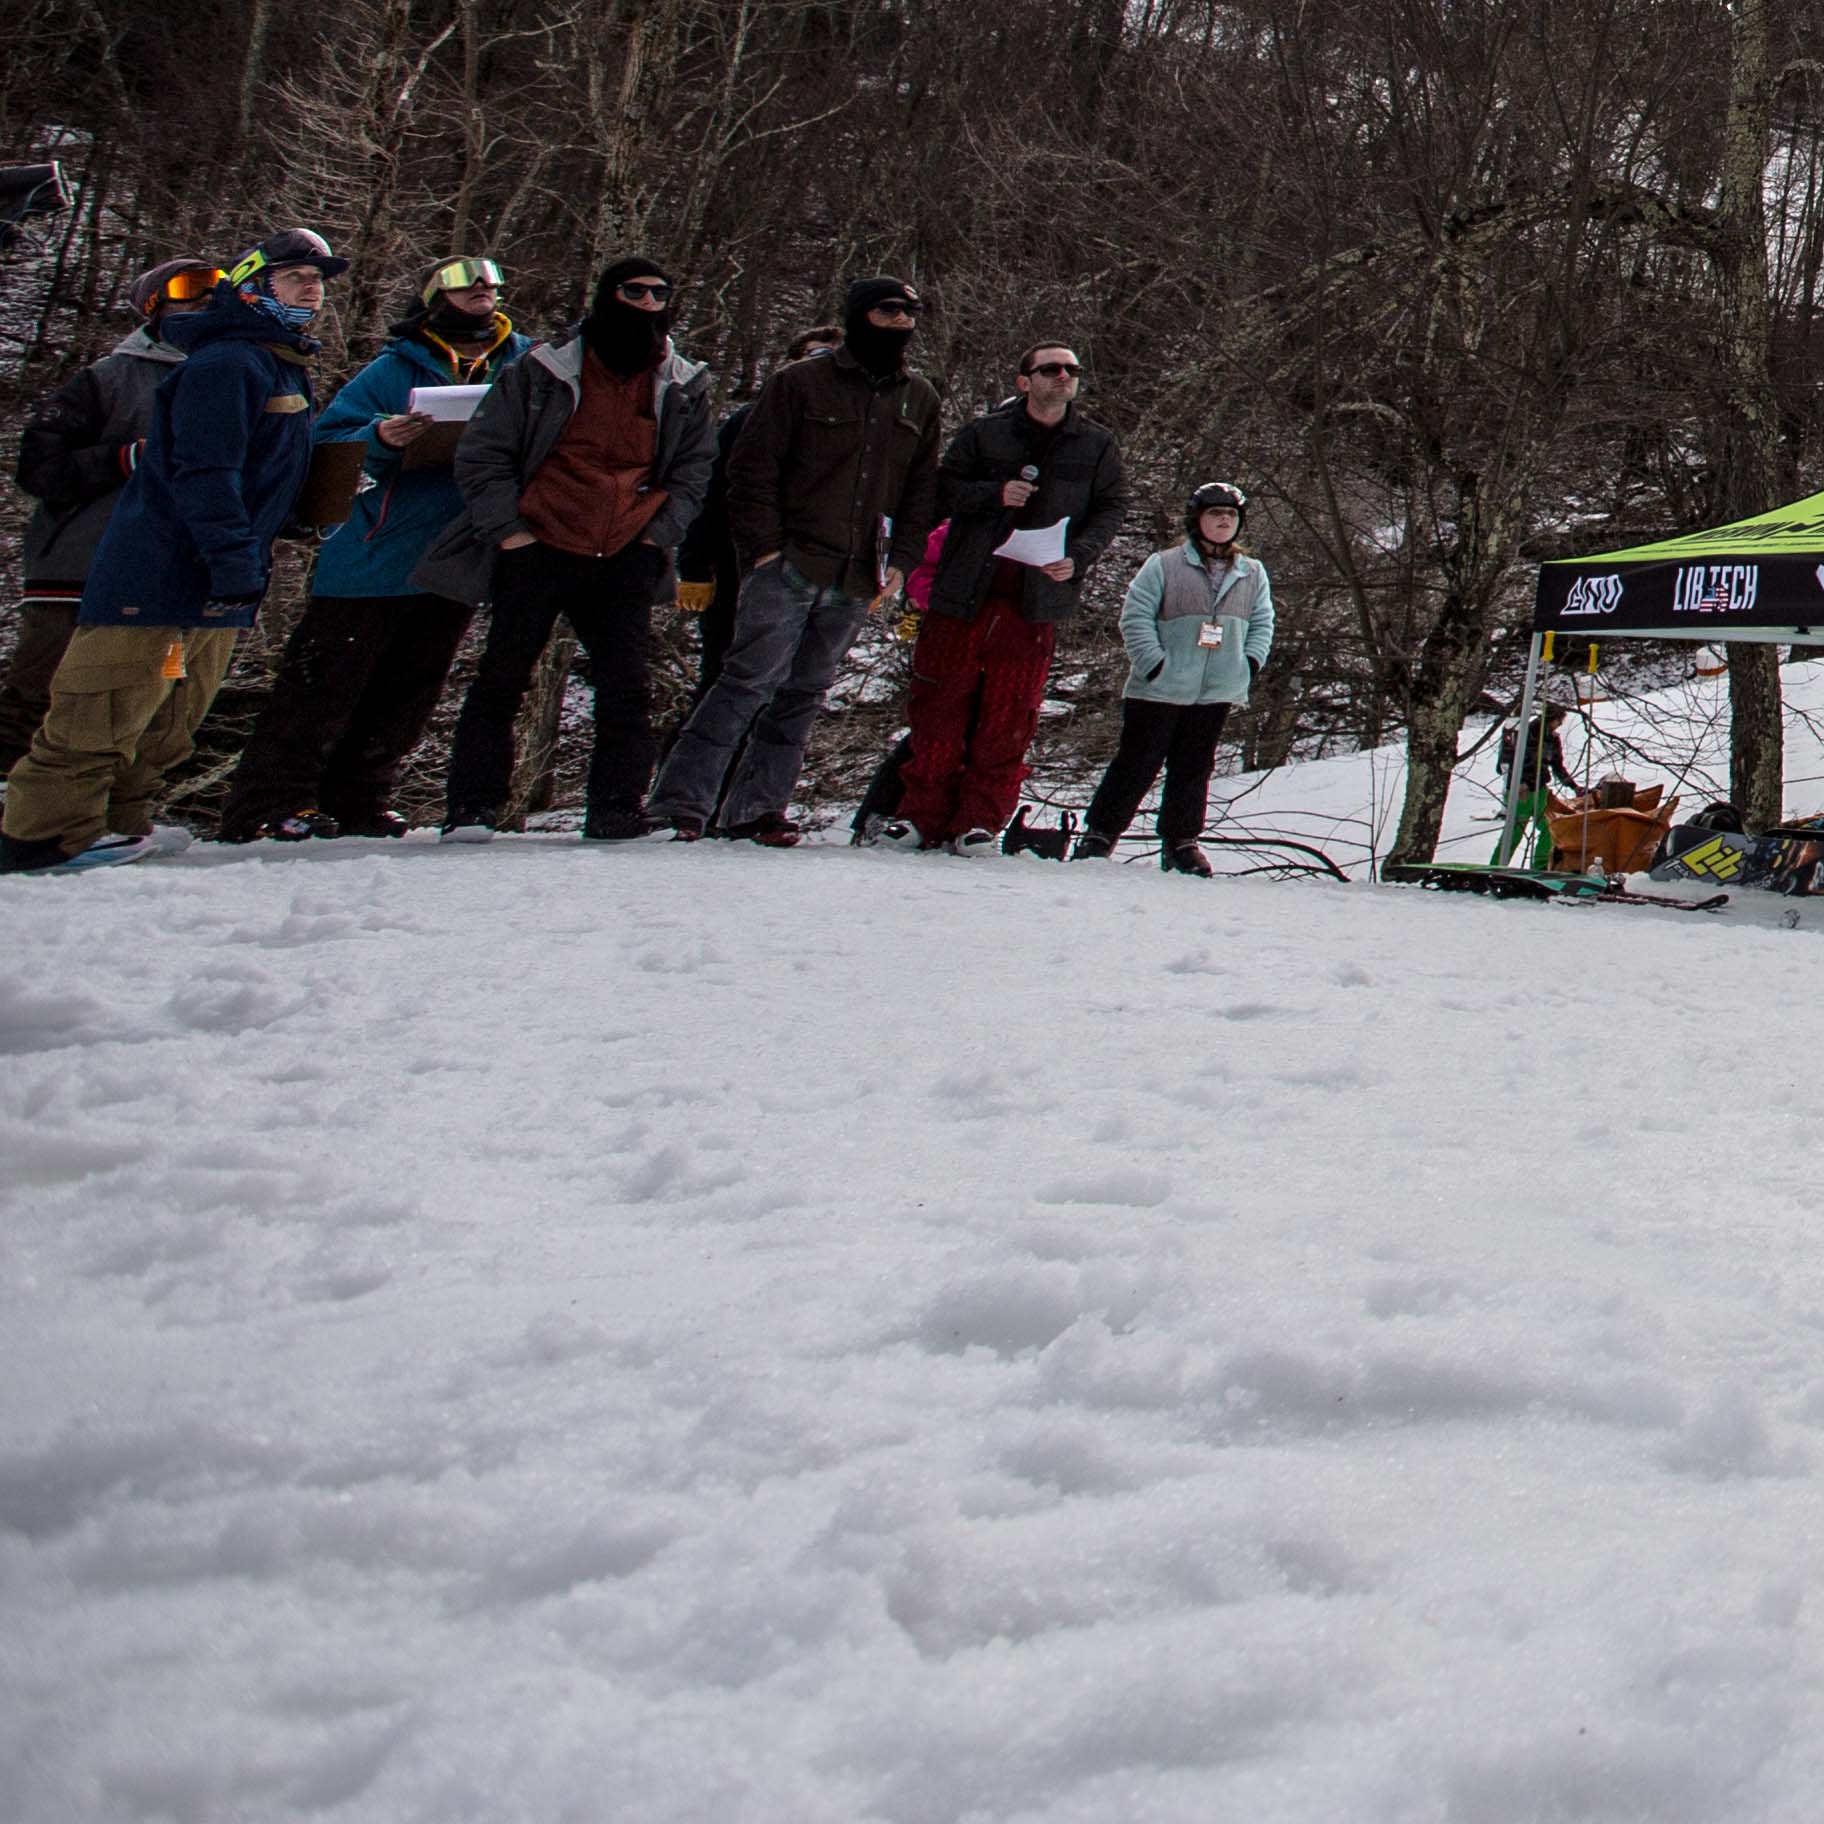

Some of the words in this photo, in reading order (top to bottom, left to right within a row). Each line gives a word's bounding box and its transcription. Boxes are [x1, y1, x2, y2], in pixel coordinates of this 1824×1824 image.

[1560, 574, 1624, 615] GNU
[1672, 567, 1706, 611] LIB
[1702, 564, 1758, 612] TECH
